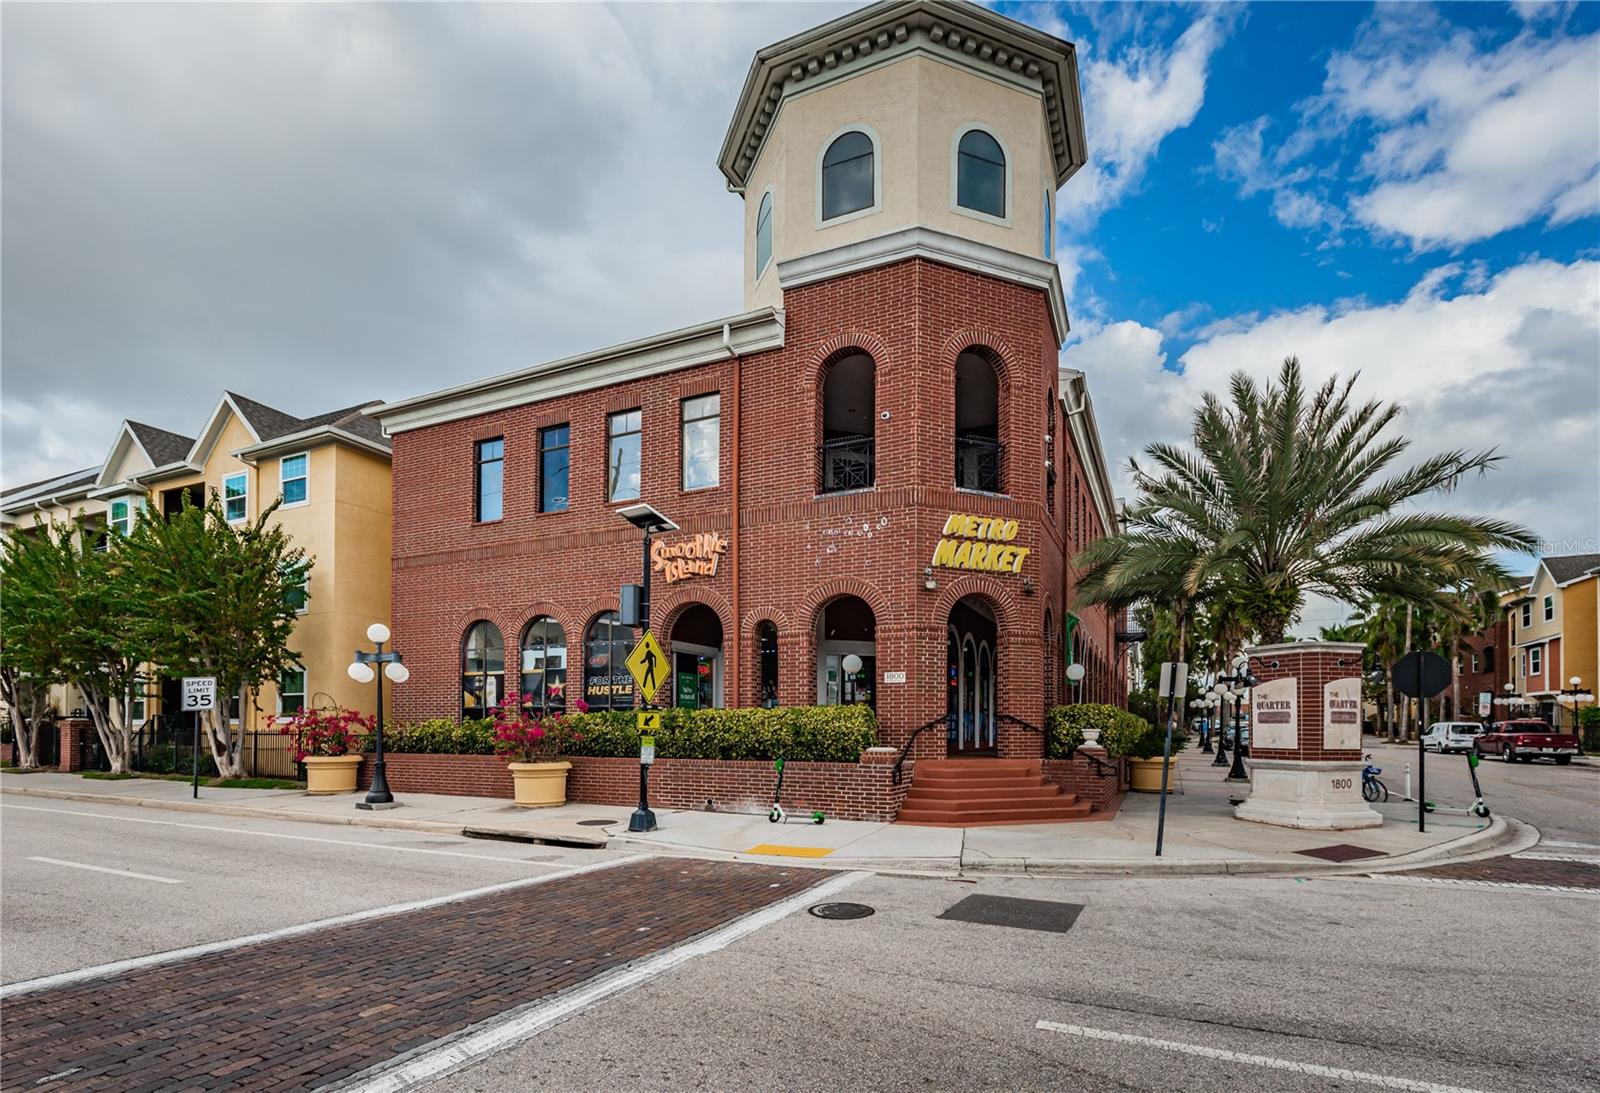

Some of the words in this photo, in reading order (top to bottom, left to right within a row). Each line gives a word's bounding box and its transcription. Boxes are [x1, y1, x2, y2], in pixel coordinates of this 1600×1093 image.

[942, 513, 1019, 541] METRO
[931, 538, 1031, 574] MARKET
[590, 676, 610, 685] FOR
[612, 675, 633, 684] THE
[886, 672, 905, 680] 1800
[587, 684, 632, 695] HUSTLE
[187, 694, 211, 707] 35
[1256, 700, 1291, 711] QUARTER
[1329, 700, 1357, 709] QUARTER
[1331, 778, 1352, 789] 1800
